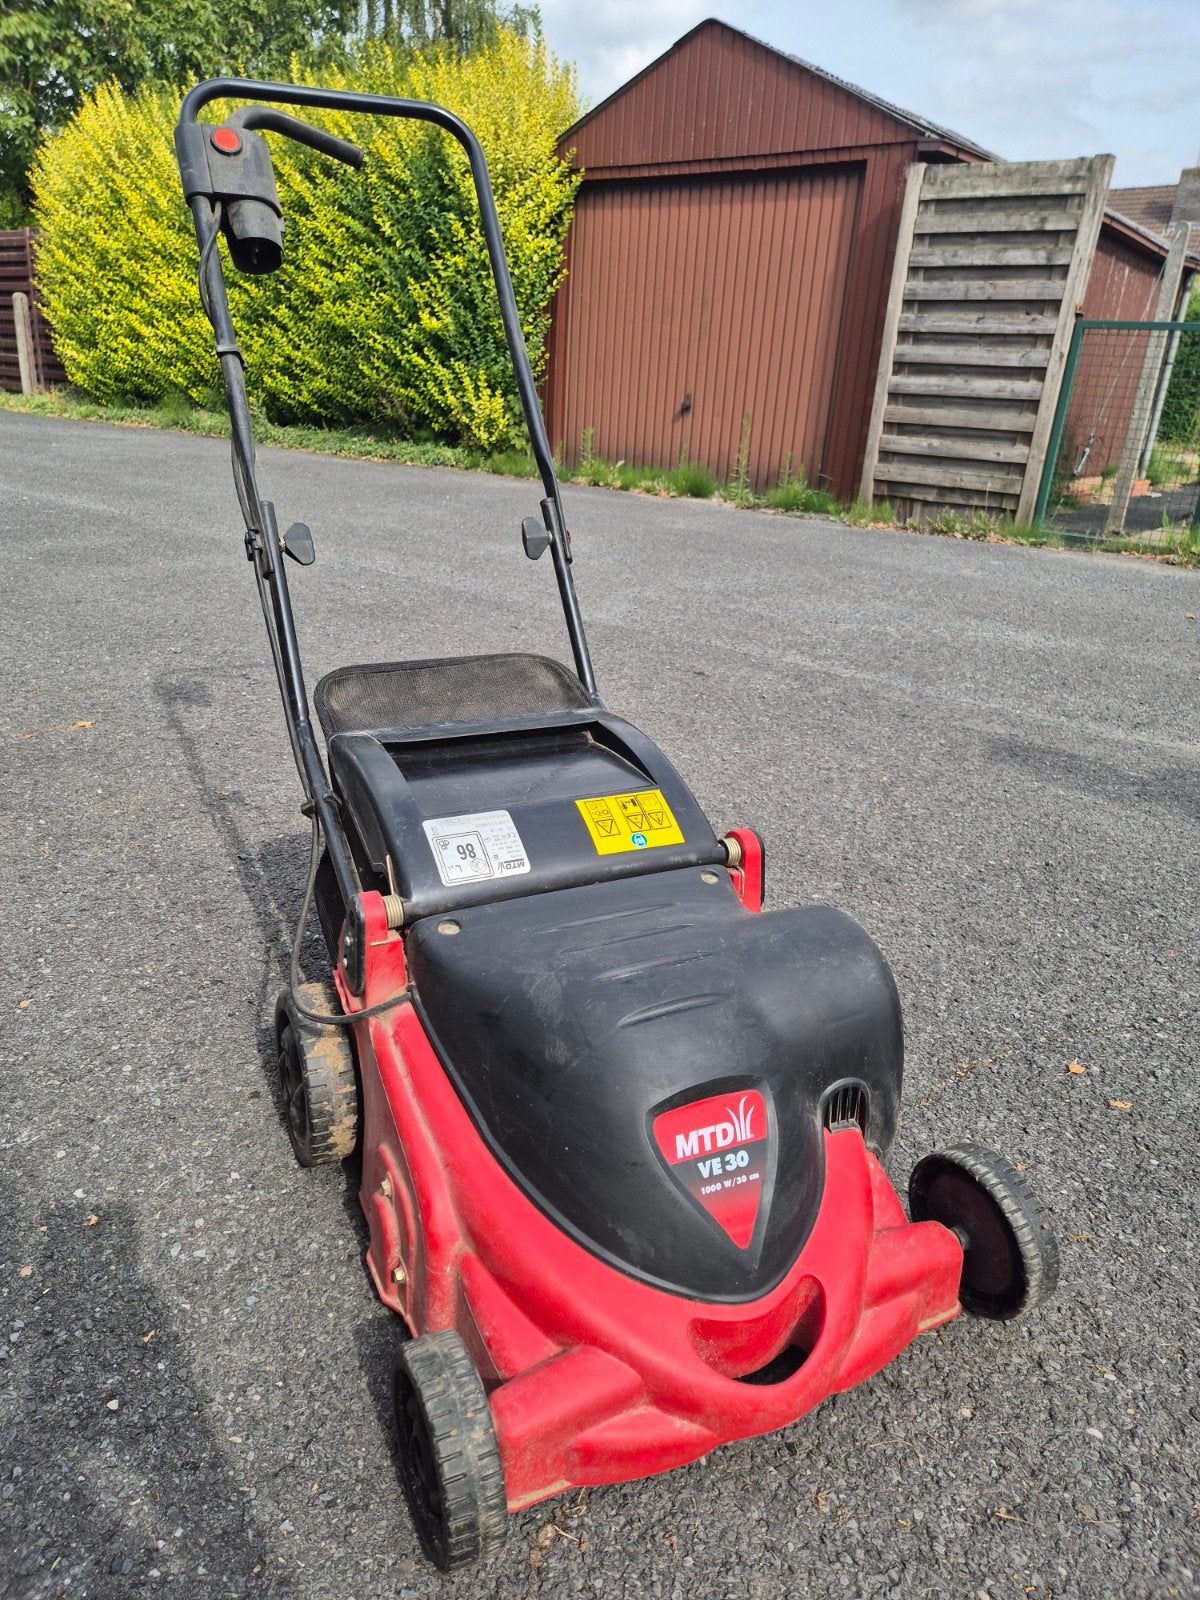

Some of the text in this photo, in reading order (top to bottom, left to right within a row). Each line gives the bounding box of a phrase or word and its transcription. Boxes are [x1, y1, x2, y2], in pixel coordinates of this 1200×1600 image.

[456, 843, 476, 860] 86
[505, 861, 525, 870] MTD
[675, 1122, 734, 1159] MTD
[698, 1150, 749, 1179] VE 30
[701, 1183, 721, 1194] 1000
[724, 1175, 747, 1188] W/30
